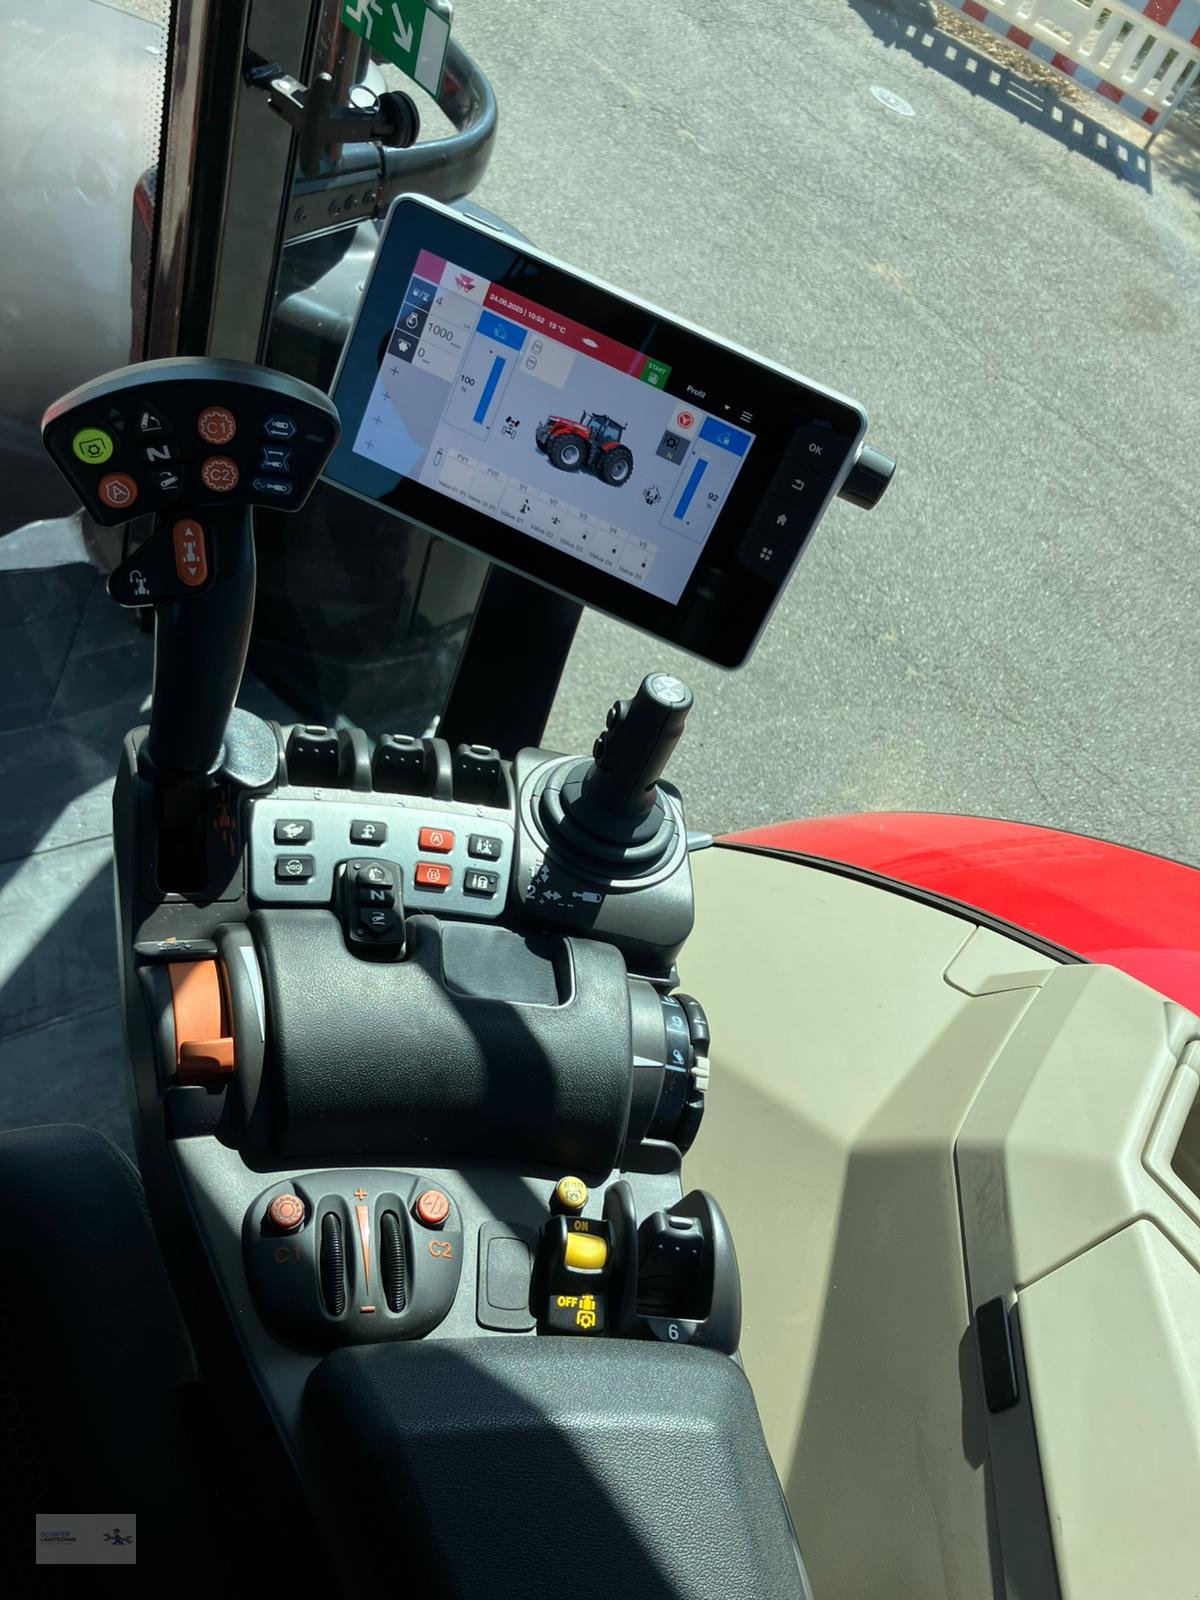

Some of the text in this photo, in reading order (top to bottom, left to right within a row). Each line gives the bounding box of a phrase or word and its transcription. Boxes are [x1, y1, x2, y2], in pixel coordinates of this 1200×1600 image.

[435, 296, 443, 306] 4
[528, 311, 546, 325] 10:52
[427, 322, 454, 342] 1000
[417, 347, 426, 358] 0
[647, 362, 667, 375] START
[460, 374, 475, 386] 100
[686, 384, 706, 399] Profil
[207, 421, 227, 434] C1
[146, 445, 171, 461] N
[808, 443, 824, 455] OK
[210, 469, 230, 481] C2
[112, 485, 127, 500] A
[707, 492, 719, 503] 92
[526, 884, 536, 899] 2
[573, 1220, 589, 1231] ON
[274, 1247, 301, 1264] C1
[428, 1240, 453, 1260] C2
[556, 1295, 578, 1308] OFF
[667, 1323, 680, 1340] 6
